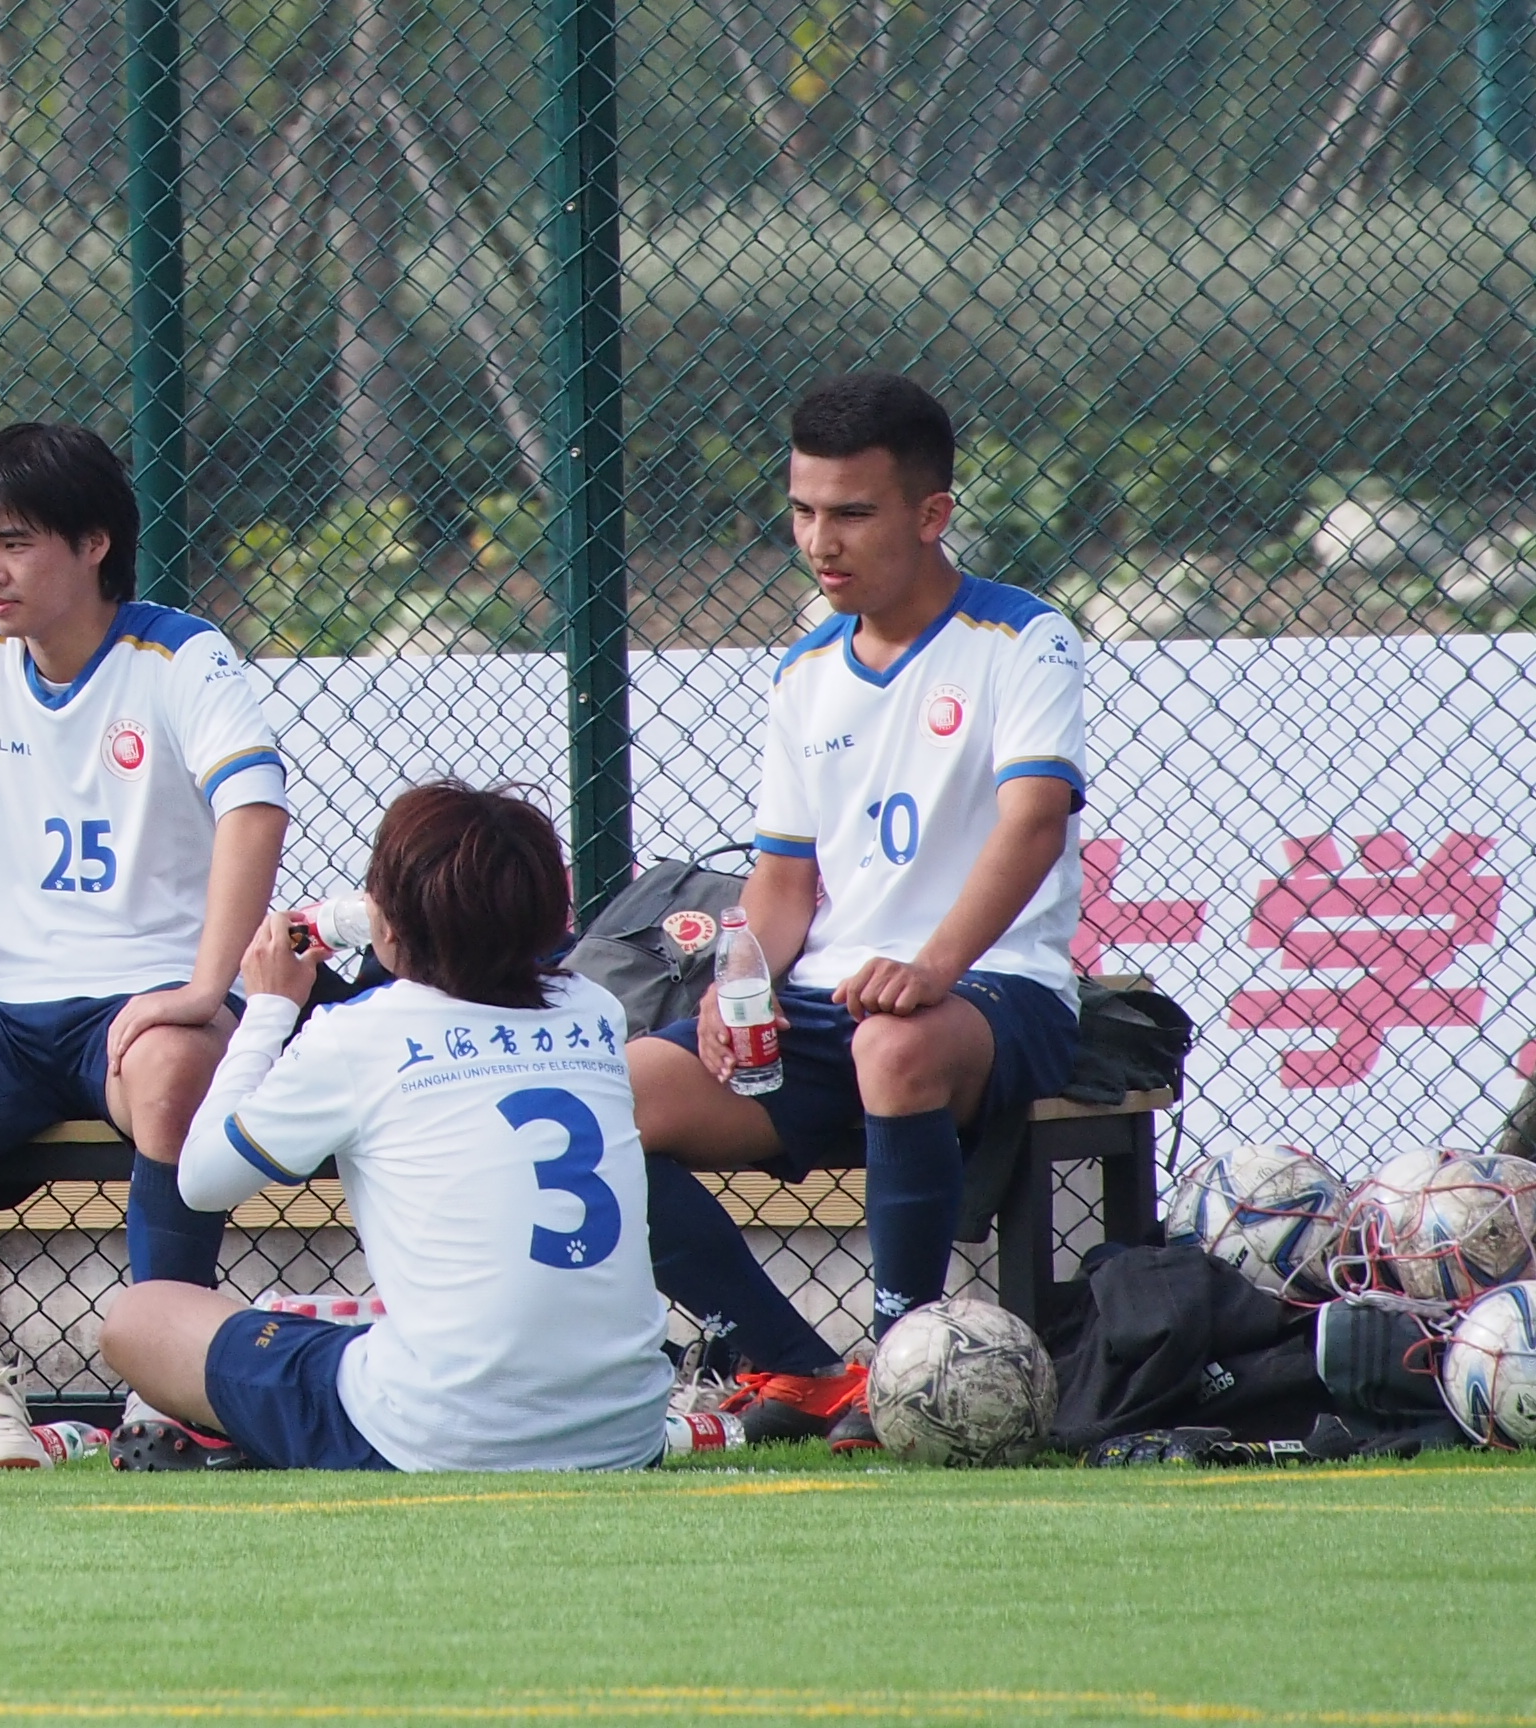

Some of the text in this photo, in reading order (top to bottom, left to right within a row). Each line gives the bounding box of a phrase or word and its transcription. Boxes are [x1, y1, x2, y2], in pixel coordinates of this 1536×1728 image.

[1038, 654, 1080, 671] KELME
[40, 817, 118, 893] 25
[400, 1071, 461, 1094] SHANGHAI
[462, 1063, 530, 1080] UNIVERSITY
[532, 1061, 549, 1073] OF
[549, 1060, 598, 1073] ELECTRIC
[495, 1087, 622, 1270] 3
